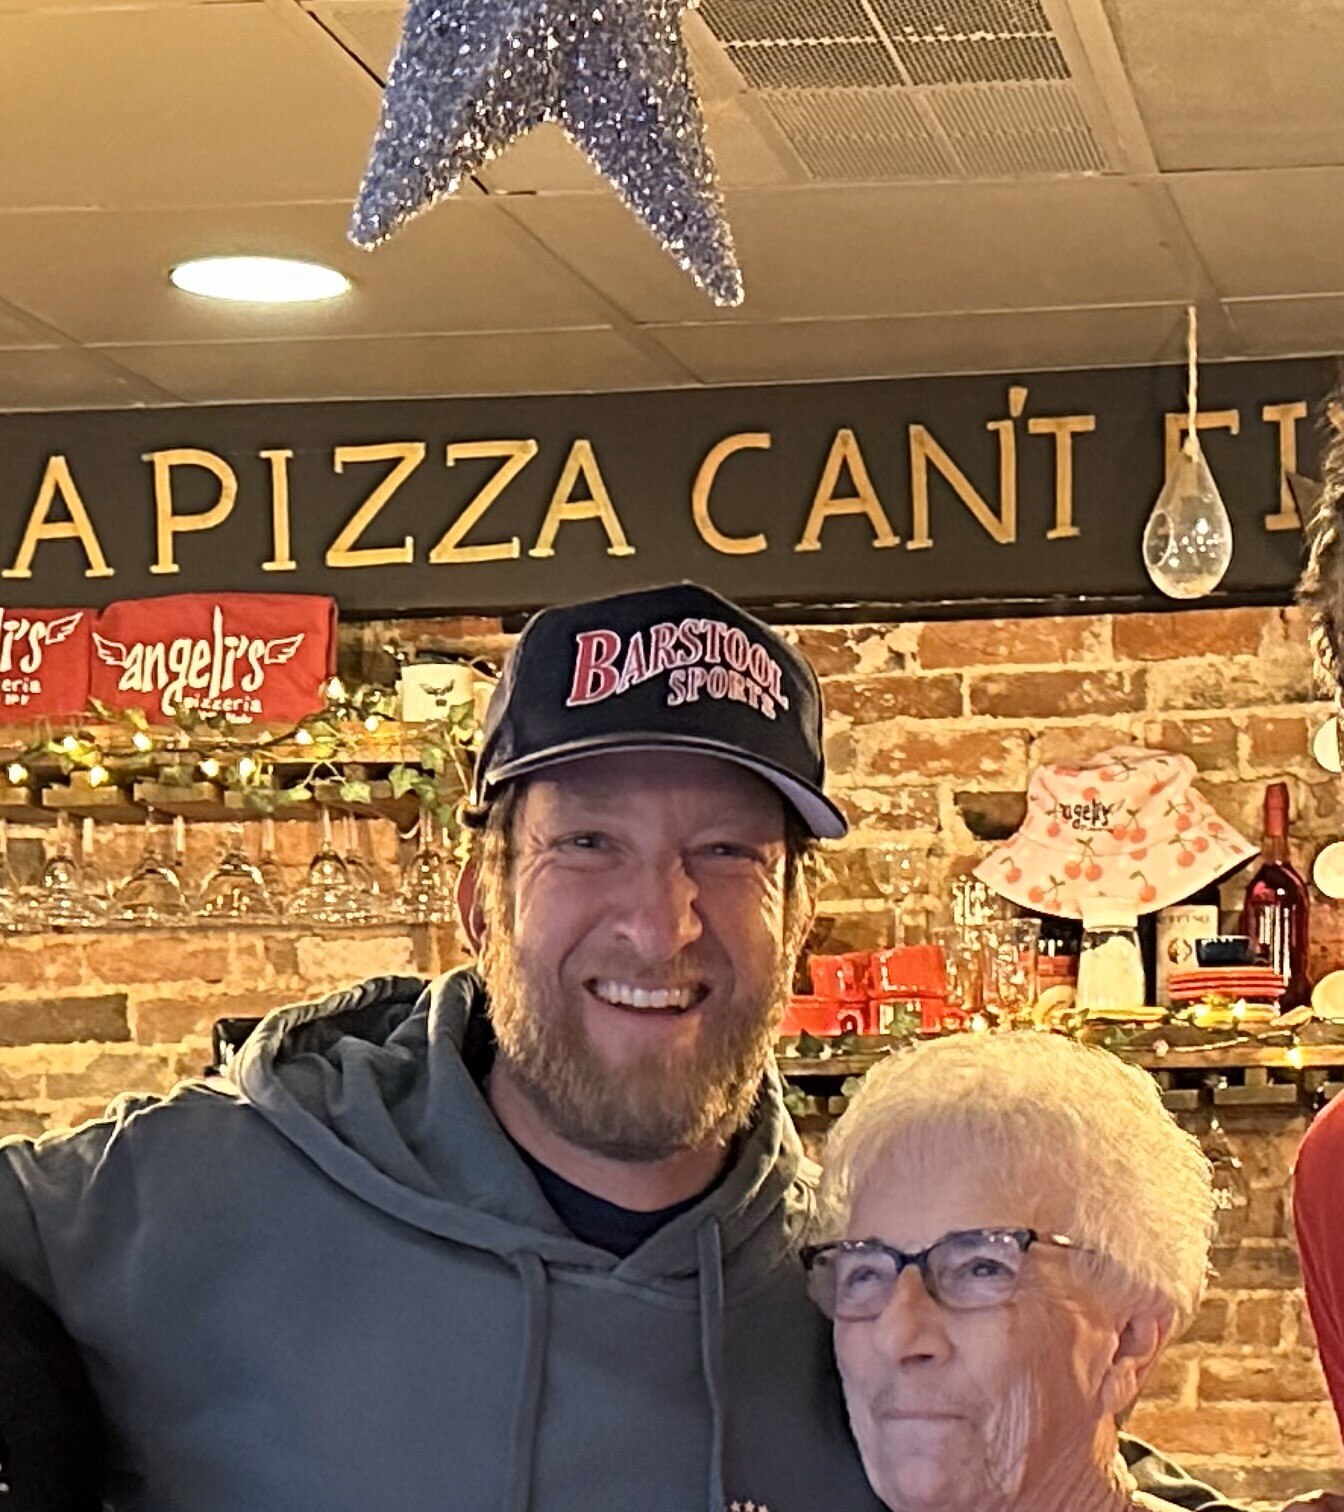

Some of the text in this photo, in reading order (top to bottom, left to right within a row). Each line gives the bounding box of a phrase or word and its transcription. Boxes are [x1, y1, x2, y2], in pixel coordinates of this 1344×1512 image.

[2, 456, 114, 578] A
[141, 438, 636, 574] PIZZA
[690, 386, 1097, 555] CAN'T
[1163, 402, 1308, 533] FI
[118, 605, 266, 717] angeli's
[566, 618, 790, 708] BARSTOOL
[666, 666, 778, 721] SPORTS
